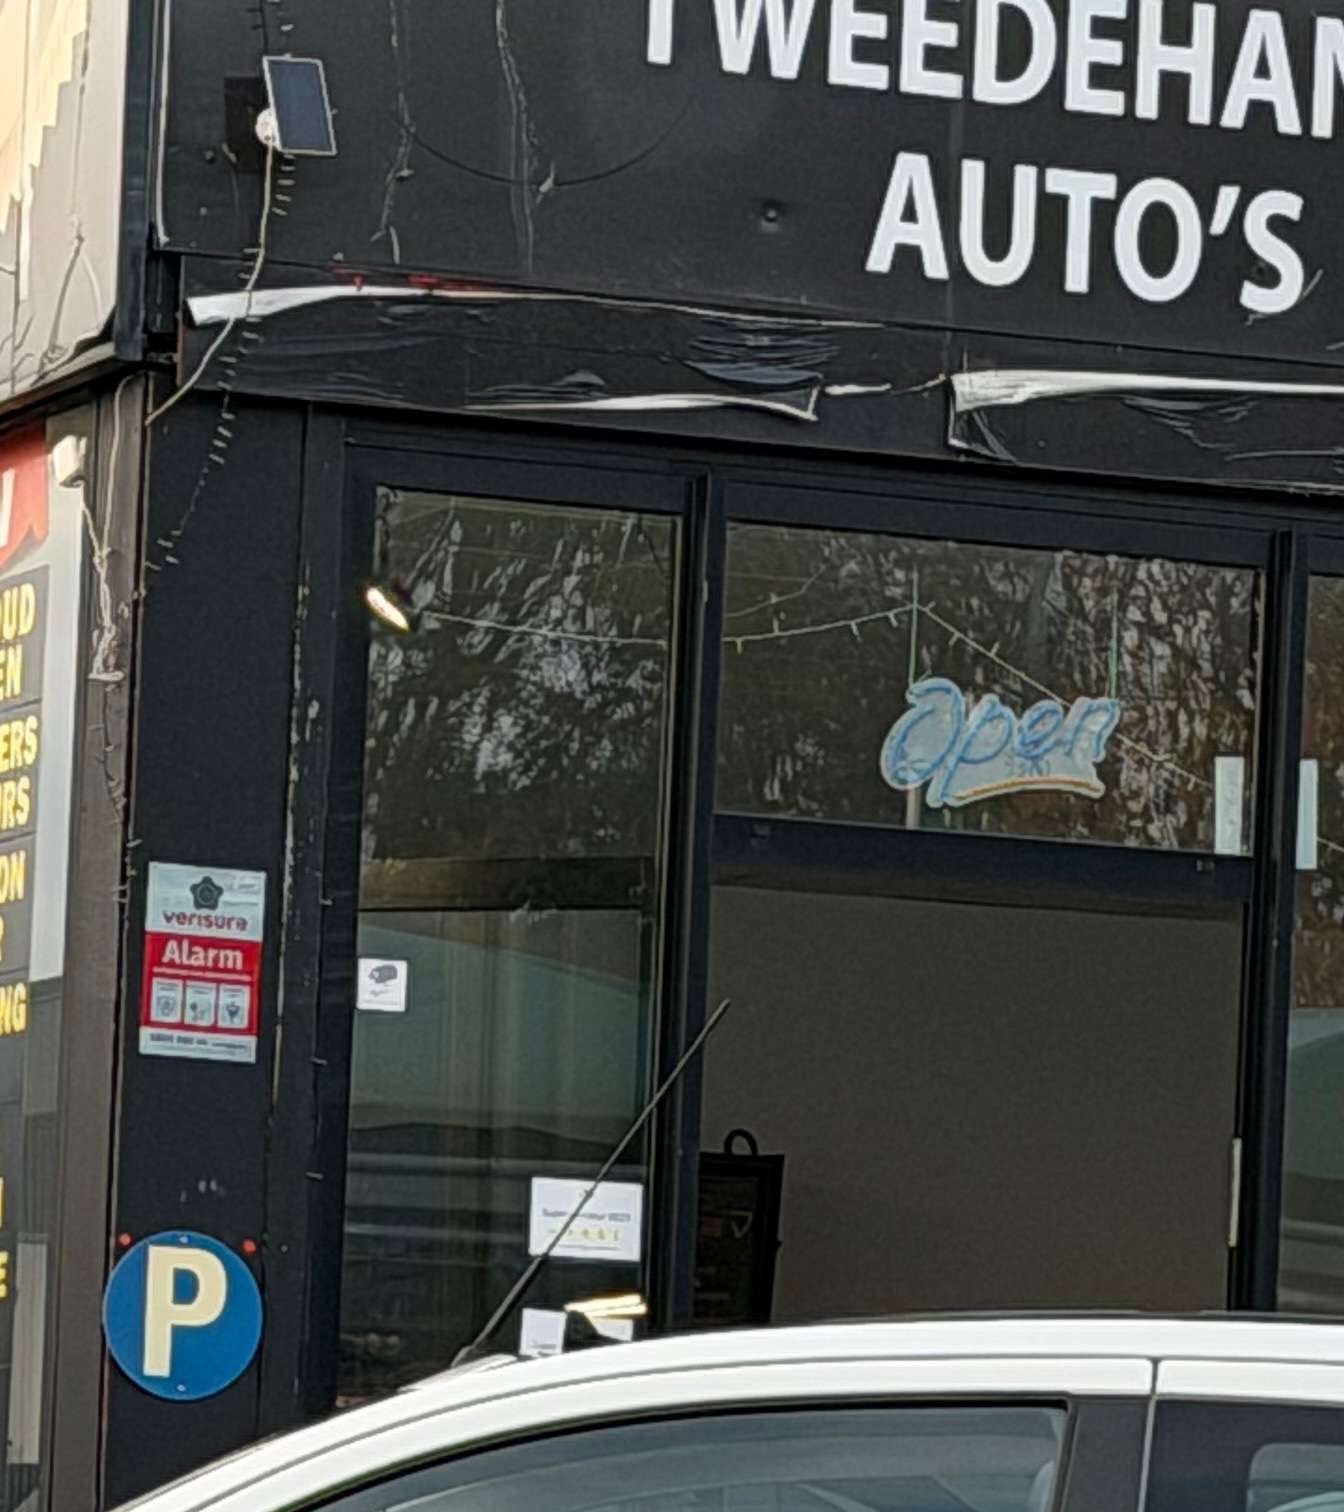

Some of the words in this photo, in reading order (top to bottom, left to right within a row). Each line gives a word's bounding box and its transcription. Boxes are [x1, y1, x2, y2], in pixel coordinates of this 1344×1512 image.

[865, 152, 1305, 313] AUTO'S
[886, 680, 1120, 804] Open
[161, 938, 244, 970] Alarm
[143, 1245, 227, 1378] P
